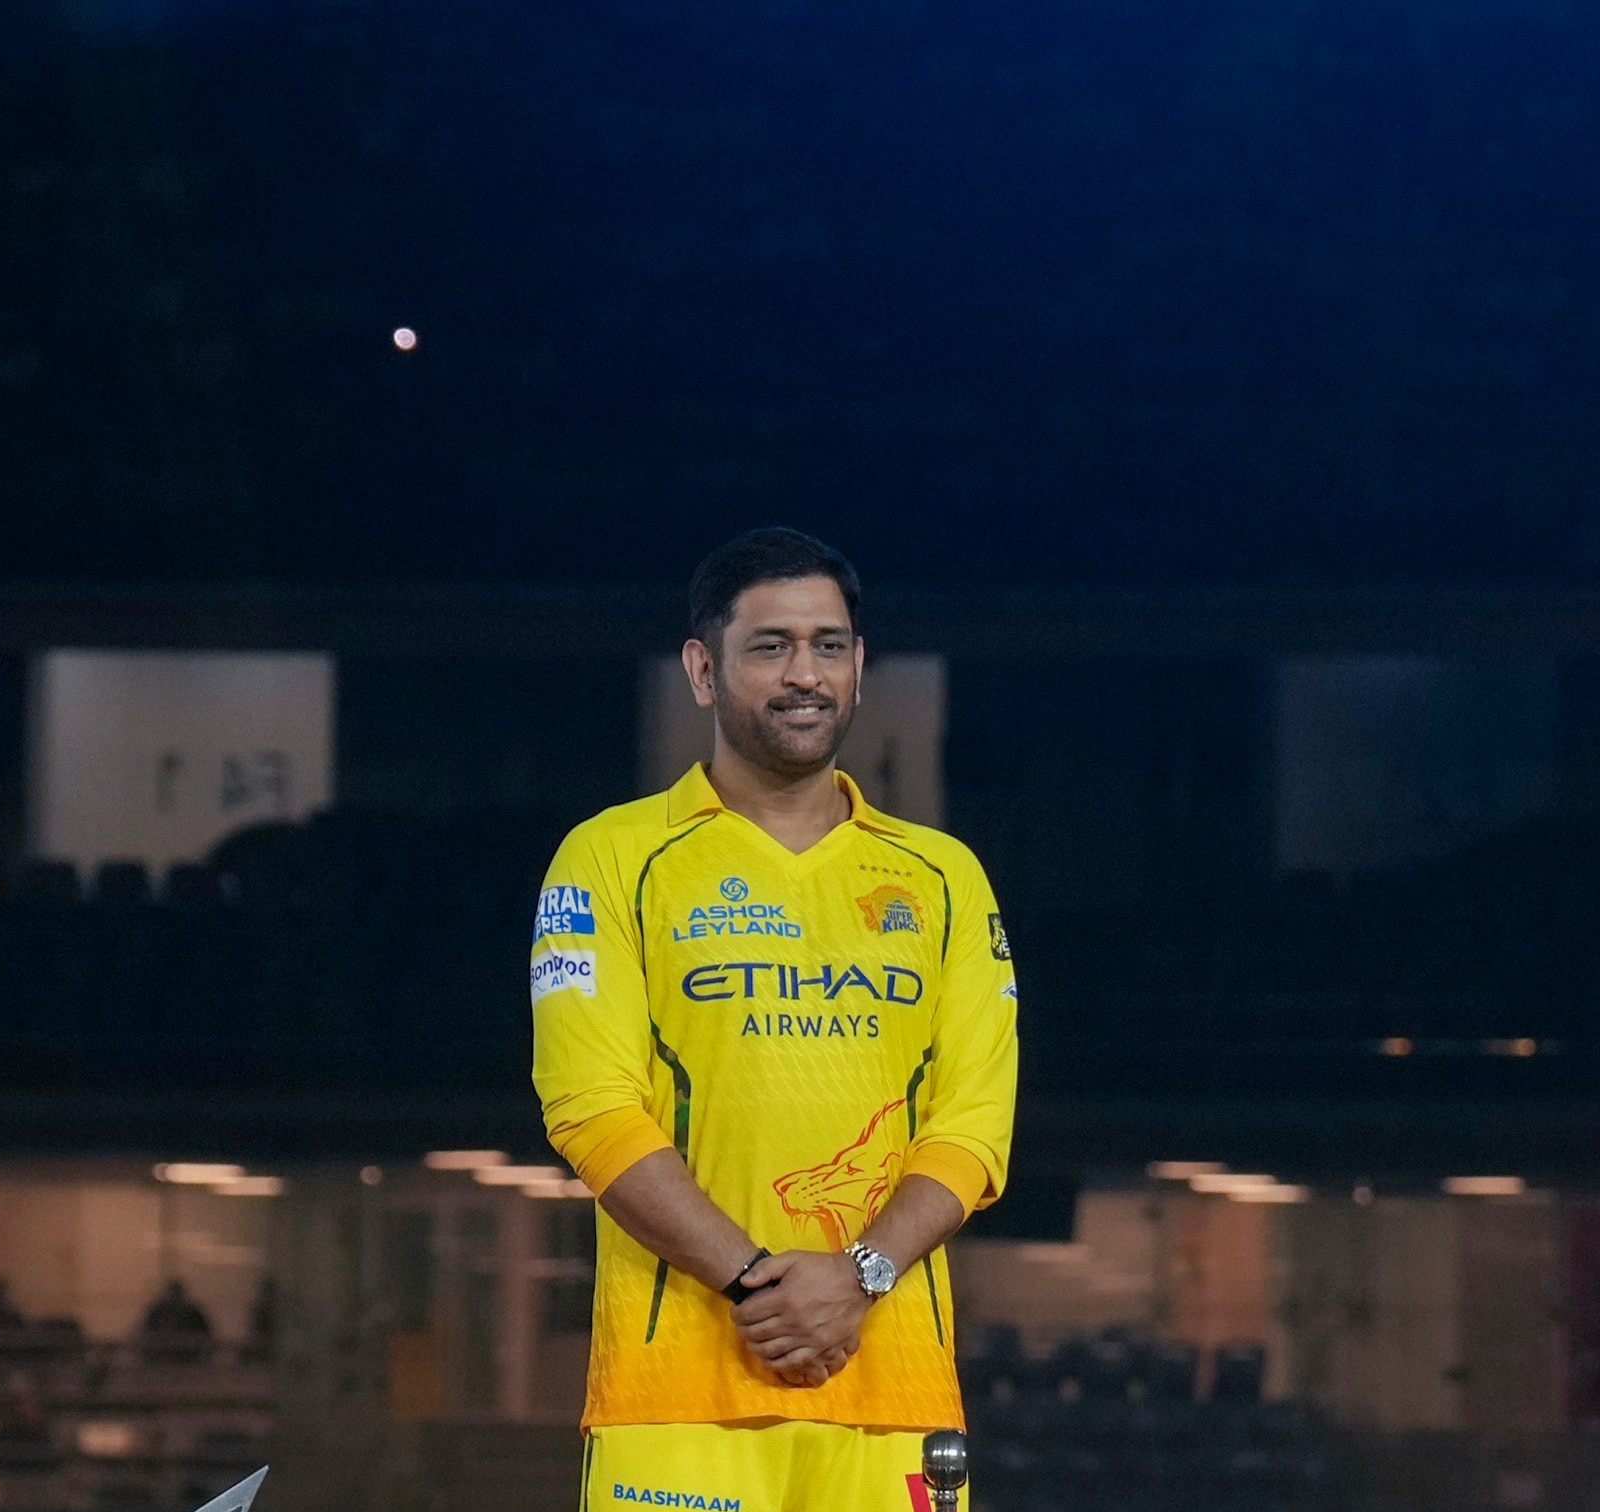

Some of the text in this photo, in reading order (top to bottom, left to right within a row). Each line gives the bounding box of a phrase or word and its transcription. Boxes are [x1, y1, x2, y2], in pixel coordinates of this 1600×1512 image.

[687, 903, 788, 921] ASHOK
[672, 920, 802, 942] LEYLAND
[551, 973, 564, 988] AI
[681, 962, 923, 1006] ETIHAD
[741, 1014, 880, 1039] AIRWAYS
